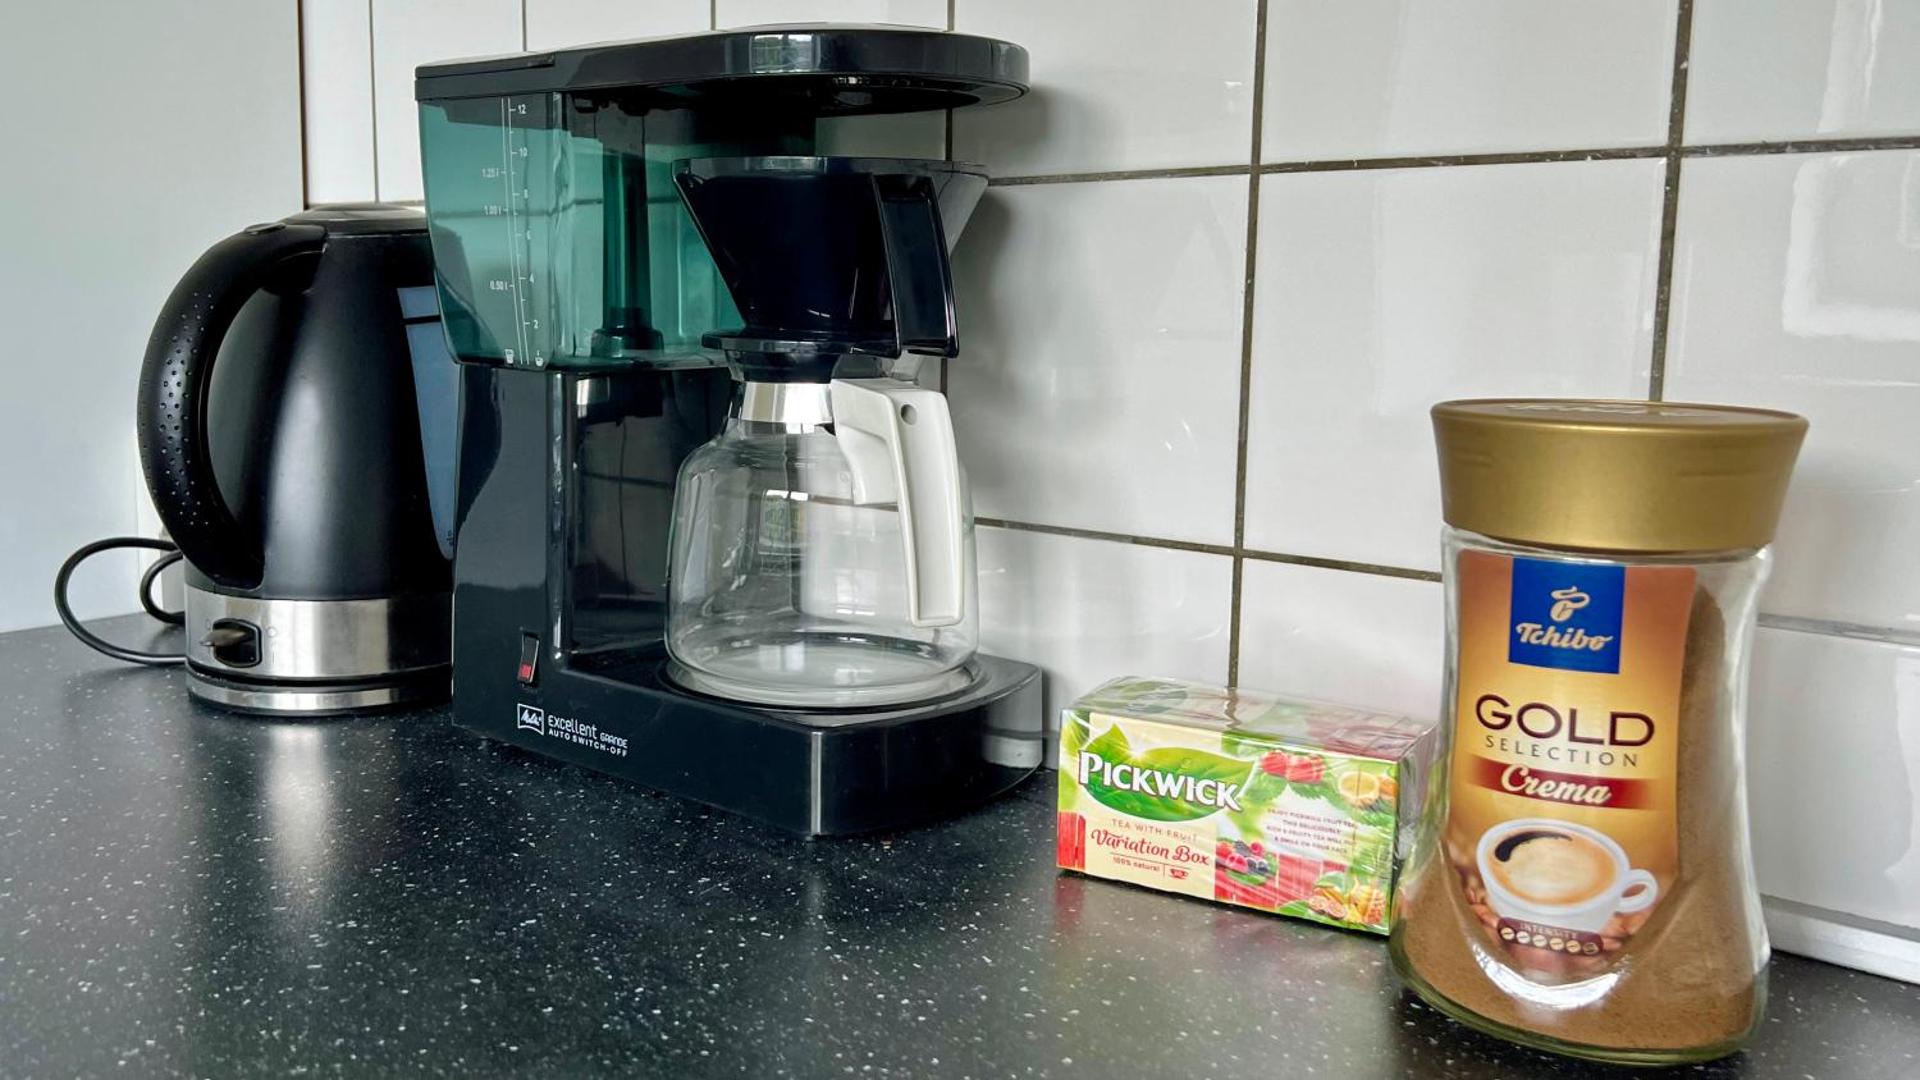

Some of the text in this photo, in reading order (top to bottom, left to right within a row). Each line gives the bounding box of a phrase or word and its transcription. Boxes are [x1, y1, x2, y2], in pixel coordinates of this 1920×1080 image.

[517, 104, 527, 114] 12
[519, 147, 528, 157] 10
[533, 320, 539, 329] 2
[1515, 622, 1614, 651] Tchibo
[1476, 694, 1655, 747] GOLD
[548, 728, 571, 741] AUTO
[1485, 735, 1638, 768] SELECTION
[1079, 750, 1243, 812] PICKWICK
[1501, 764, 1612, 805] Crema
[1111, 818, 1198, 842] TEA WITH FRUIT
[1090, 828, 1210, 866] Variation Box
[1112, 857, 1160, 872] 100% natural
